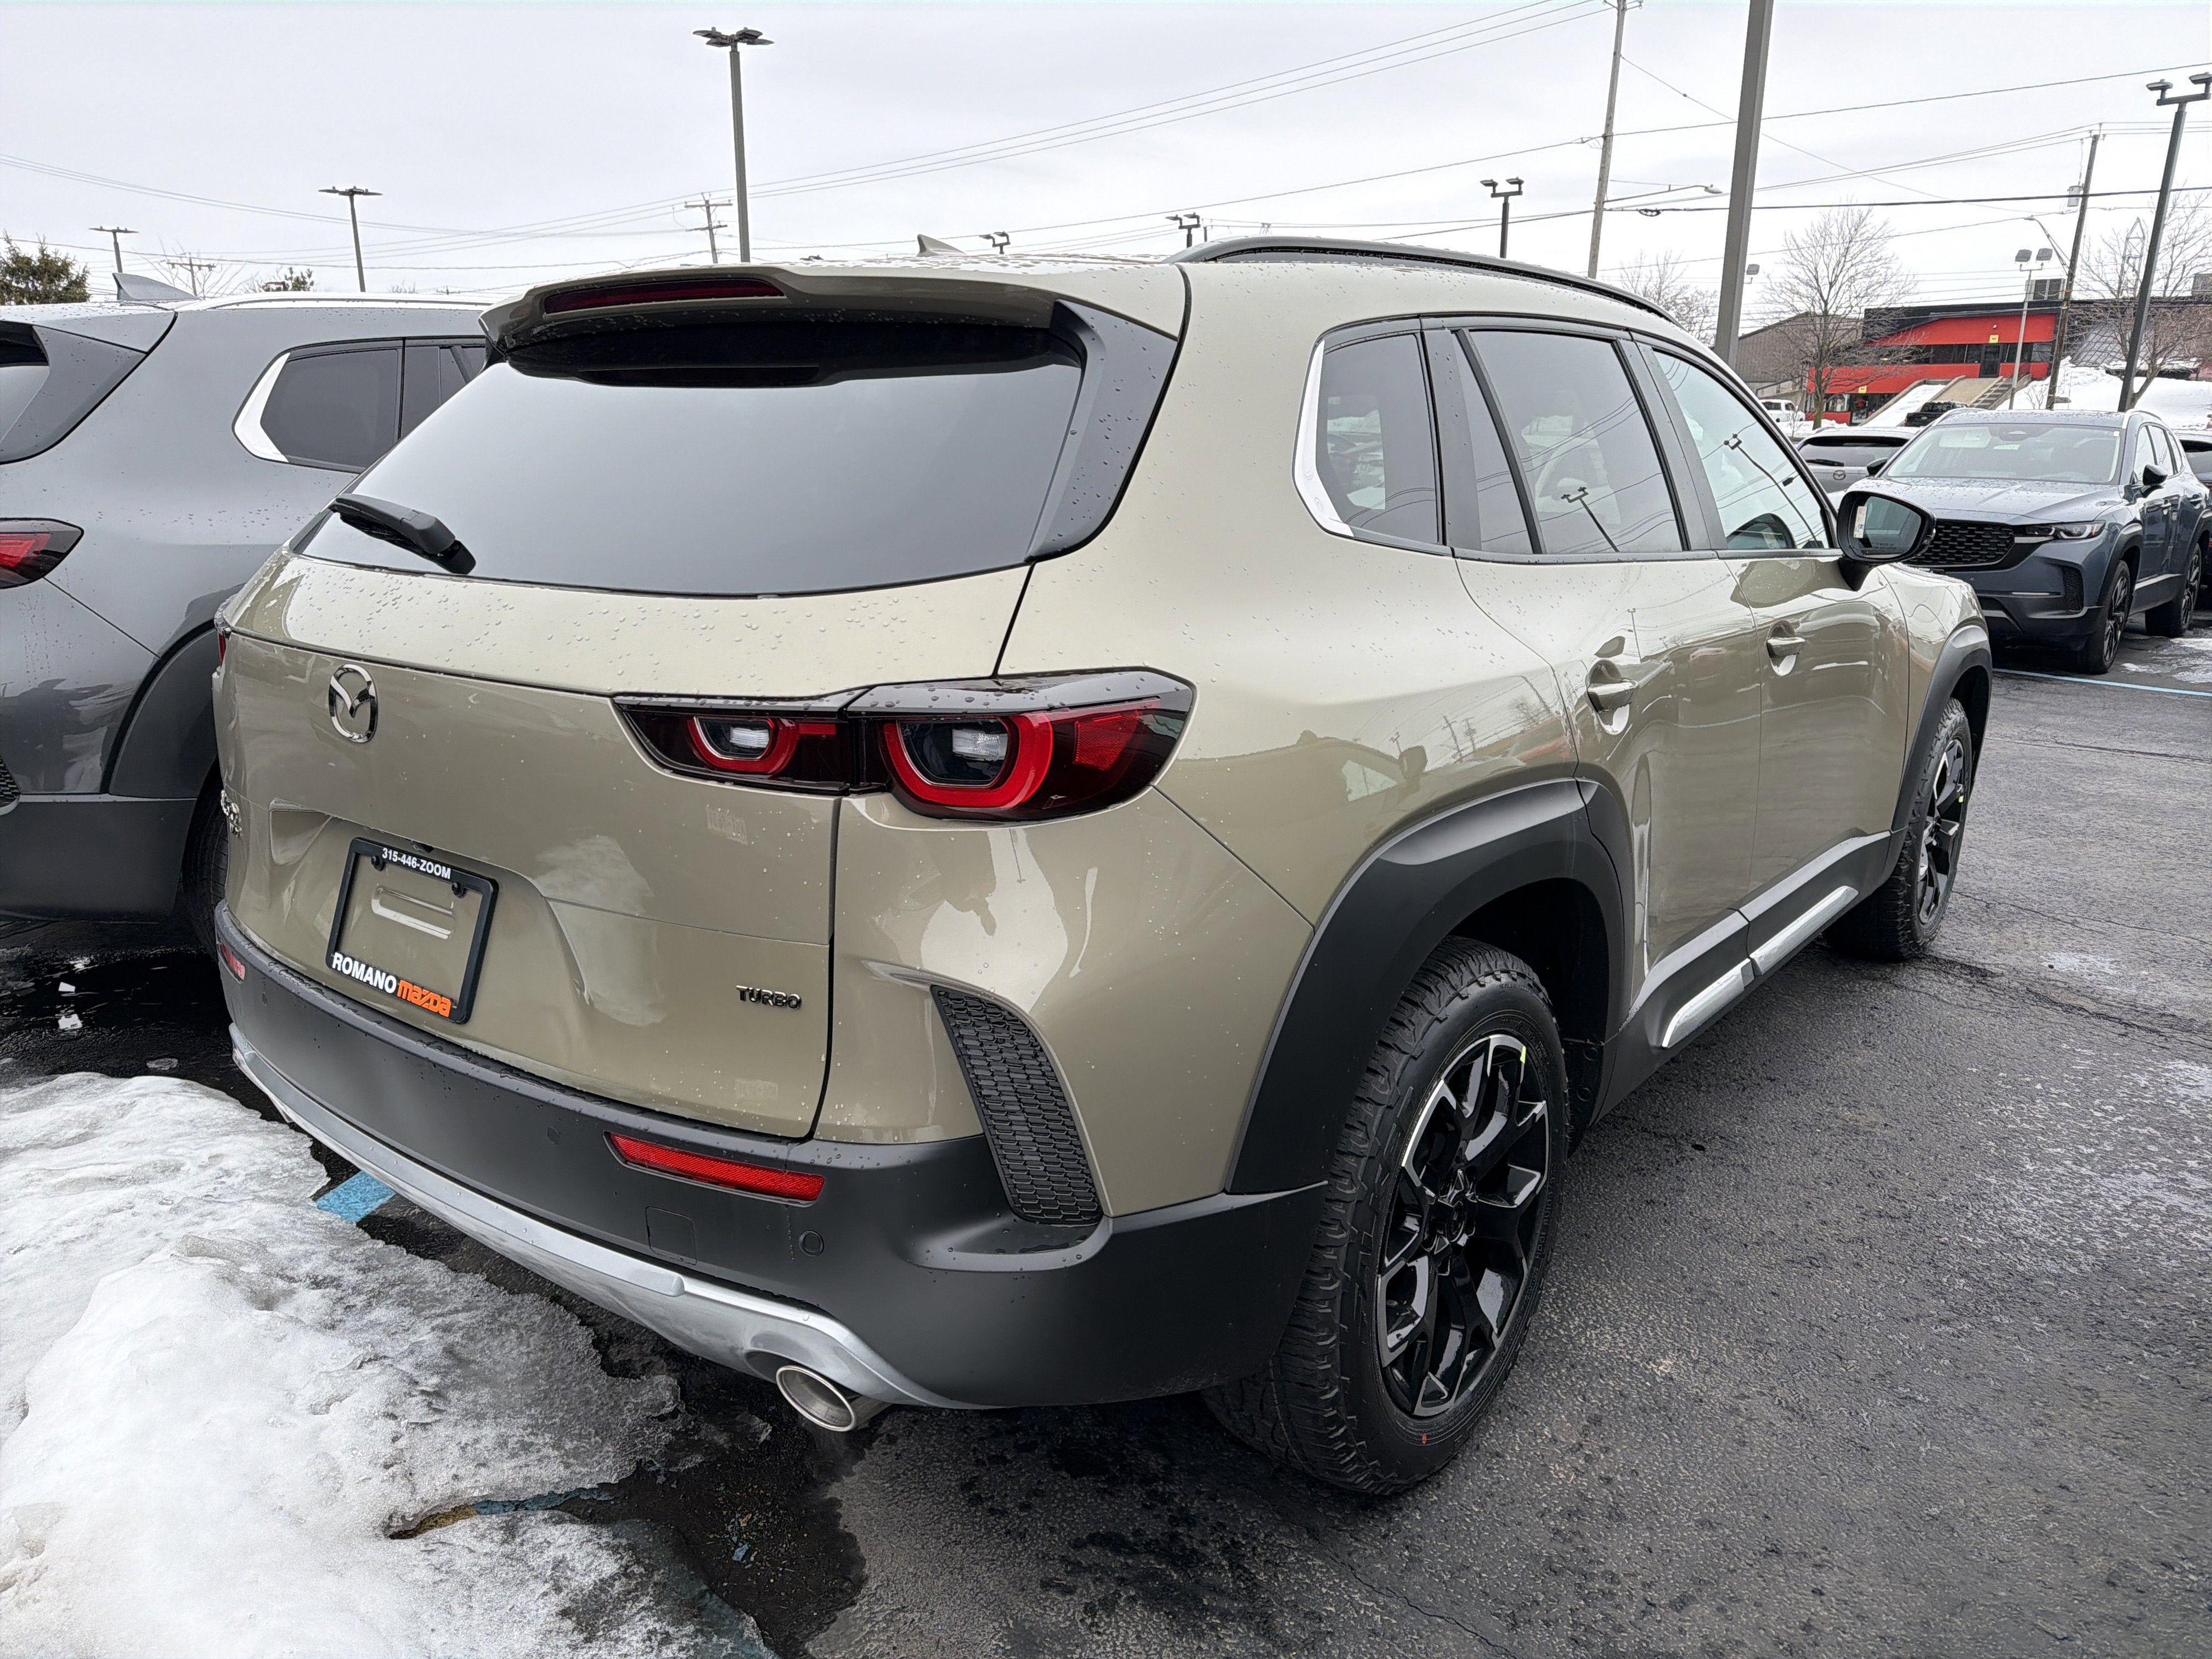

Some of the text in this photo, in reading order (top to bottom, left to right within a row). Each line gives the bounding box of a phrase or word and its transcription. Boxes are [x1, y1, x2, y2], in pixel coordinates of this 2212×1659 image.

[382, 847, 451, 879] 315-446-ZOOM
[332, 952, 397, 994] ROMANO
[736, 985, 802, 1009] TURBO
